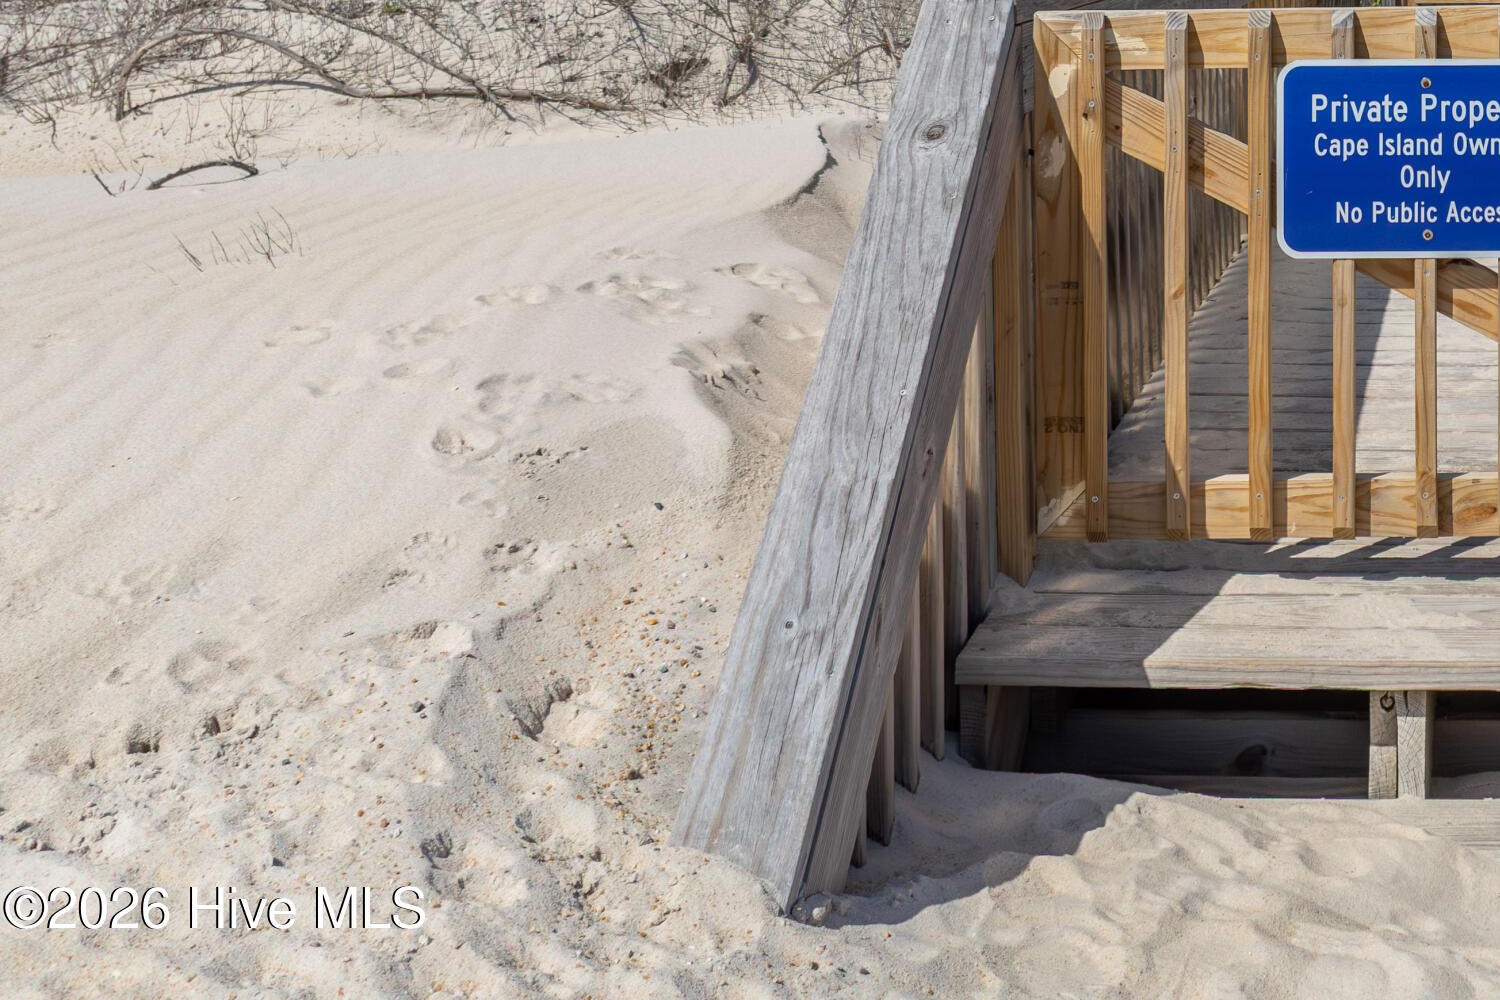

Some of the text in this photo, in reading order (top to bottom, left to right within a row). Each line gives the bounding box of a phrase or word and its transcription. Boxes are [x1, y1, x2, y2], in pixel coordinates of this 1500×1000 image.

[1312, 94, 1407, 122] Private
[1315, 133, 1368, 161] Cape
[1379, 133, 1442, 155] Island
[1401, 165, 1450, 193] Only
[1336, 202, 1362, 223] No
[1373, 201, 1437, 223] Public
